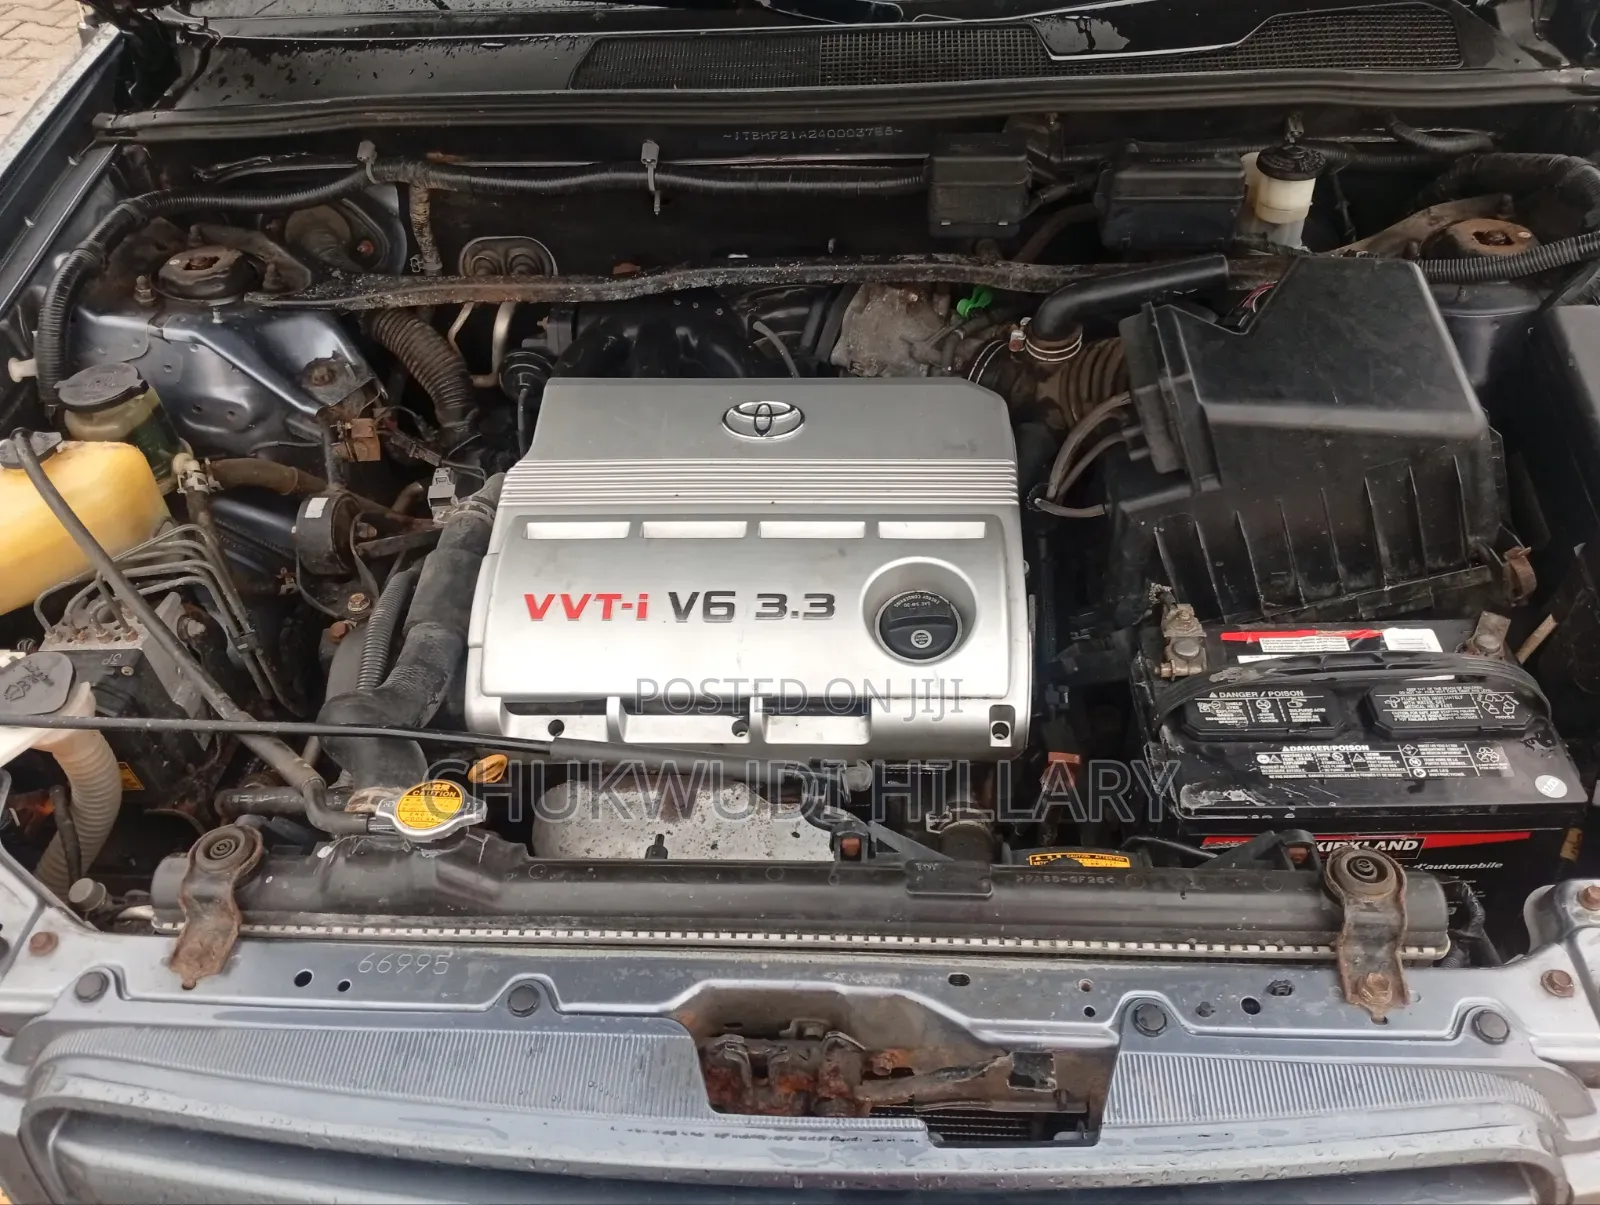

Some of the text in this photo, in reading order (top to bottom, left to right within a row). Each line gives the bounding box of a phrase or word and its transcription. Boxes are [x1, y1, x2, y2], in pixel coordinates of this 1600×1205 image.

[524, 591, 835, 623] VVT-i V6 3.3
[412, 790, 457, 798] CAUTION
[357, 952, 450, 975] 66995
